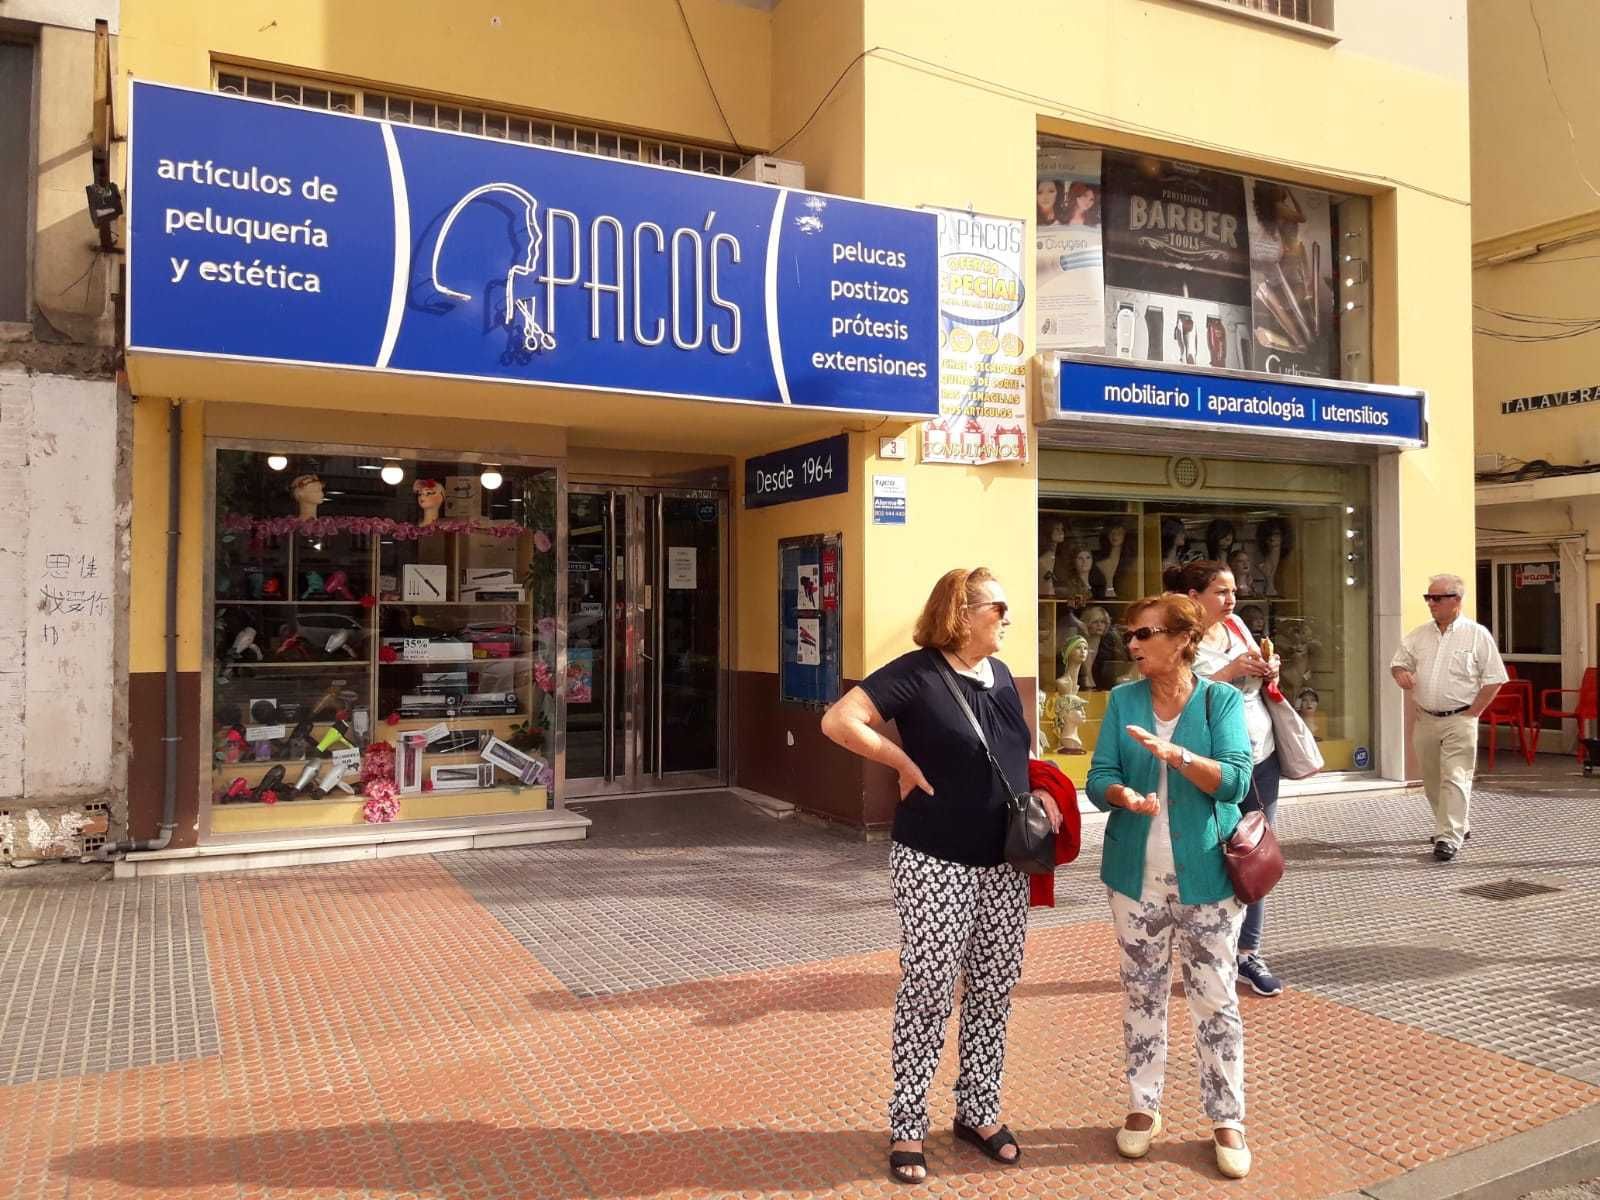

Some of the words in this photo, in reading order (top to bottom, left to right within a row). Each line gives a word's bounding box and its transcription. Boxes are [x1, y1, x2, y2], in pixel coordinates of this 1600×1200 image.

[157, 159, 292, 196] artículos
[301, 175, 338, 203] de
[165, 207, 329, 248] peluquería
[1129, 194, 1238, 249] BARBER
[832, 241, 907, 269] pelucas
[1167, 232, 1200, 250] TOOLS
[170, 257, 189, 283] y
[199, 260, 321, 293] estética
[831, 280, 909, 305] postizos
[832, 313, 909, 341] prótesis
[811, 351, 927, 378] extensiones
[1104, 383, 1190, 408] mobiliario
[1207, 395, 1305, 421] aparatología
[1322, 405, 1389, 426] utensilios
[1505, 387, 1600, 413] TALAVERA
[890, 441, 897, 454] 3
[756, 463, 794, 494] Desde
[801, 452, 834, 486] 1964
[403, 638, 430, 649] 35%
